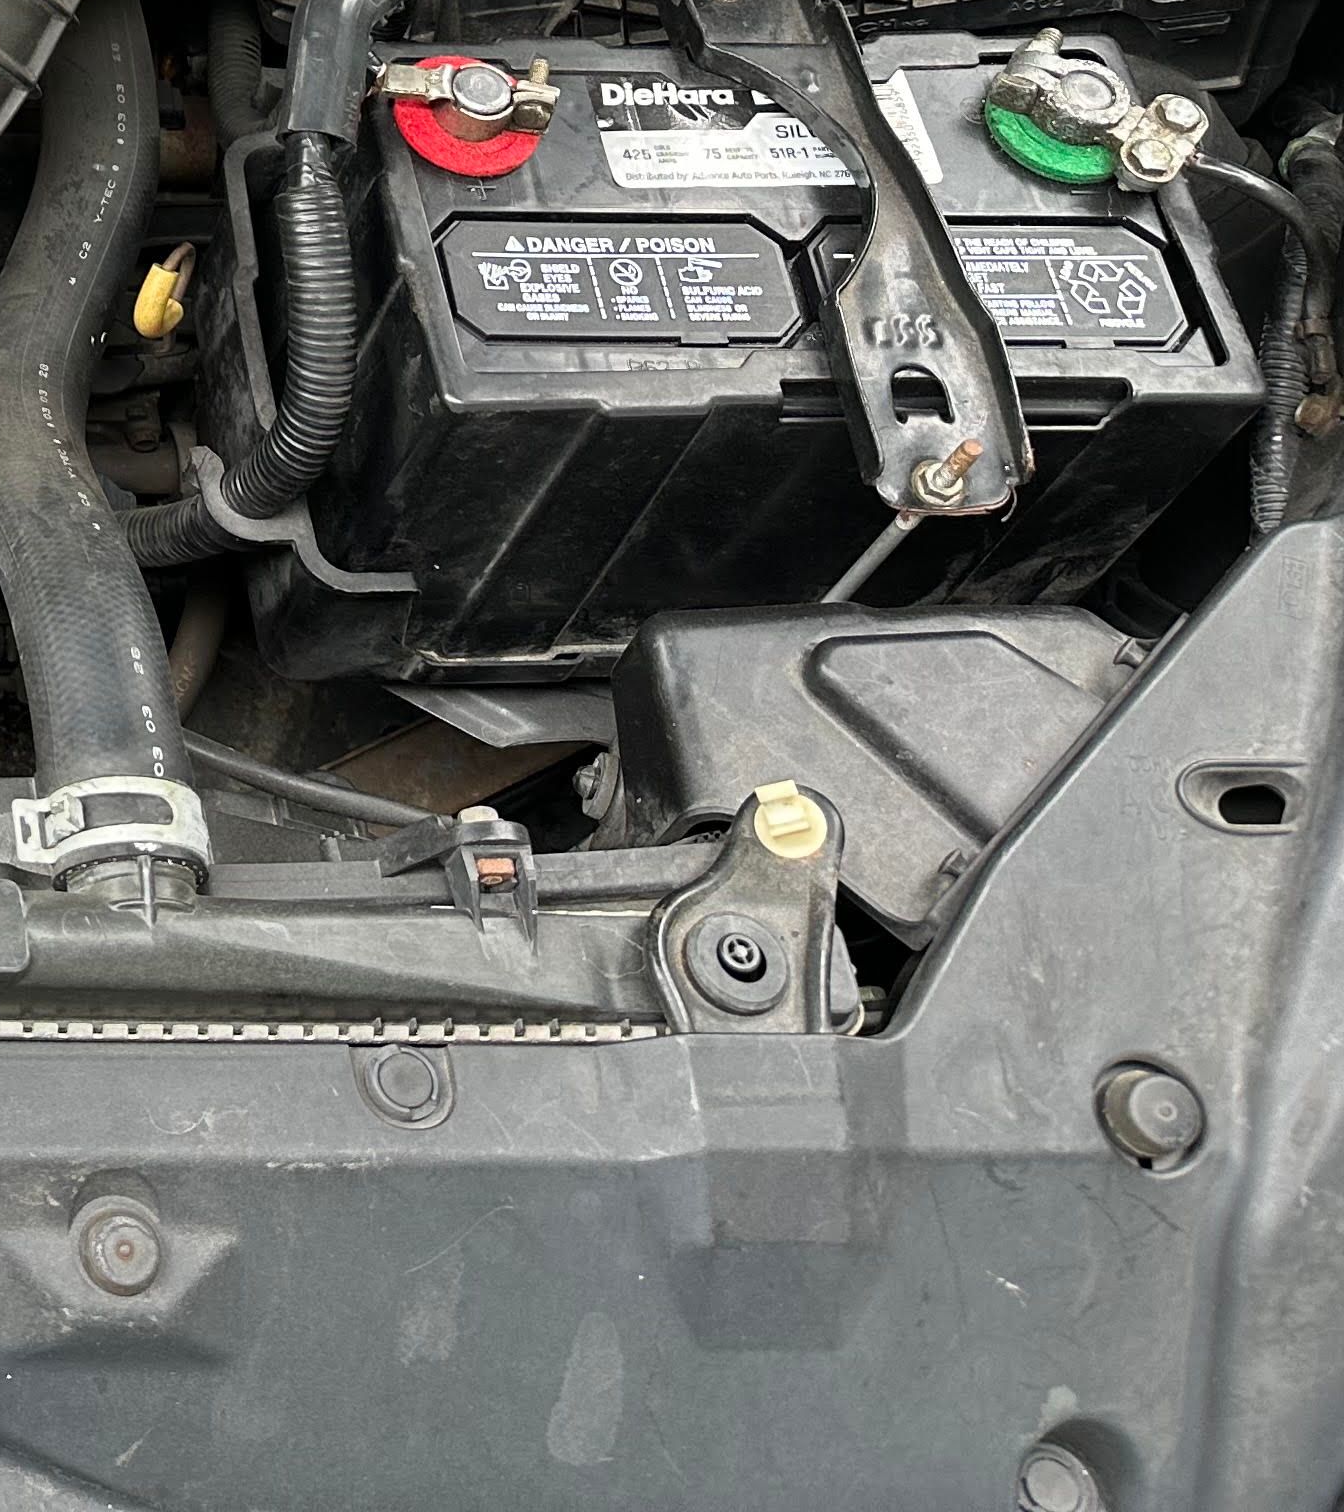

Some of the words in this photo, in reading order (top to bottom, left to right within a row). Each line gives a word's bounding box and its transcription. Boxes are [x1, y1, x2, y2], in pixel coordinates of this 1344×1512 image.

[115, 83, 126, 104] 03
[116, 112, 127, 133] 03
[775, 124, 818, 139] SIL
[705, 147, 722, 160] 75
[769, 147, 809, 159] 51R-1
[93, 179, 116, 223] Y-TEC
[525, 237, 614, 253] DANGER
[635, 237, 716, 253] POISON
[540, 264, 580, 274] SHIELD
[543, 274, 572, 283] EYES
[519, 283, 581, 293] EXPLOSIVE
[621, 286, 639, 296] NO
[141, 705, 156, 734] 03
[153, 746, 165, 777] 03
